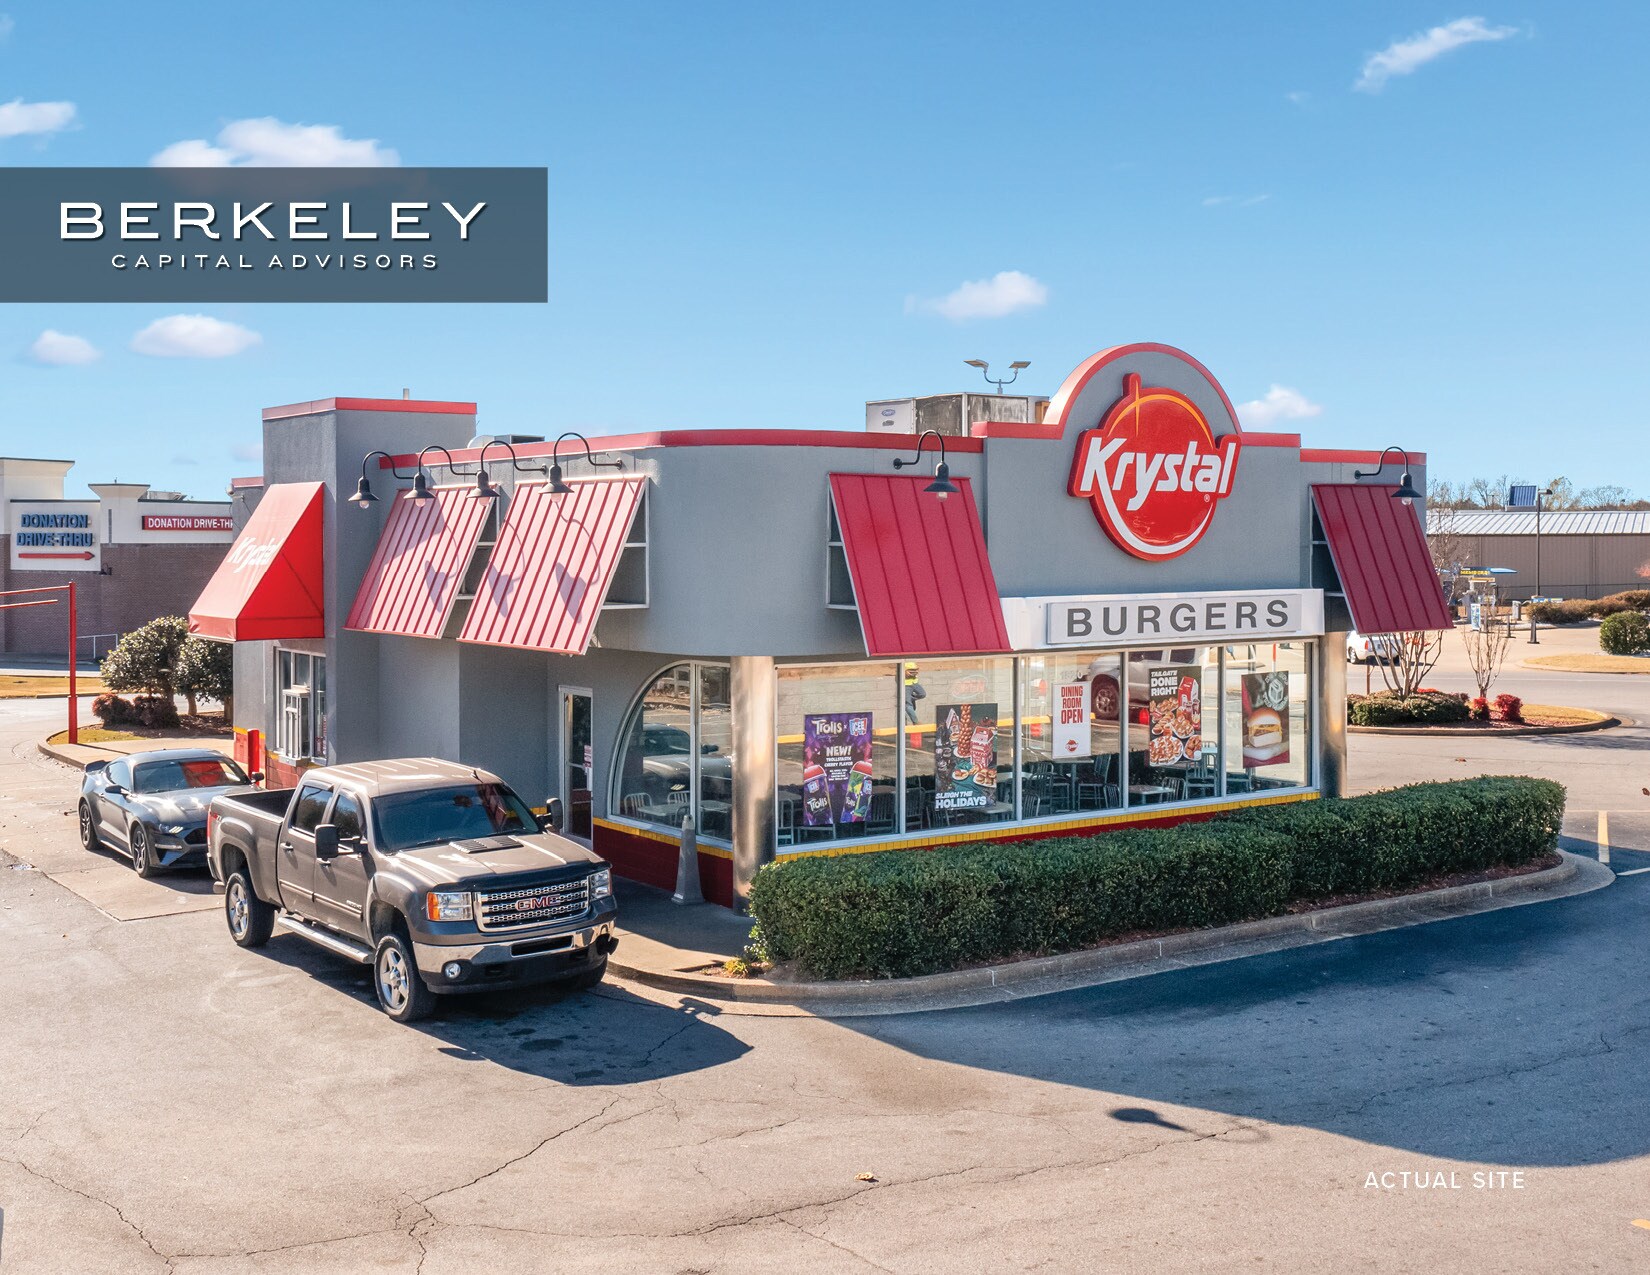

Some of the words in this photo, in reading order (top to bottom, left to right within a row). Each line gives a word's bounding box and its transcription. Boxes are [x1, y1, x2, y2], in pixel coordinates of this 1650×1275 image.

[1080, 436, 1237, 512] Krystal
[20, 513, 89, 528] DONATION
[148, 517, 192, 529] DONATION
[16, 532, 93, 547] DRIVE-THRU
[1066, 599, 1290, 638] BURGERS
[1151, 677, 1178, 687] DONE
[1061, 685, 1084, 698] DINING
[1151, 687, 1178, 697] RIGHT
[1062, 697, 1083, 709] ROOM
[1061, 708, 1084, 724] OPEN
[825, 745, 852, 757] NEW!
[935, 791, 960, 799] SLEIGH
[935, 796, 987, 808] HOLIDAYS
